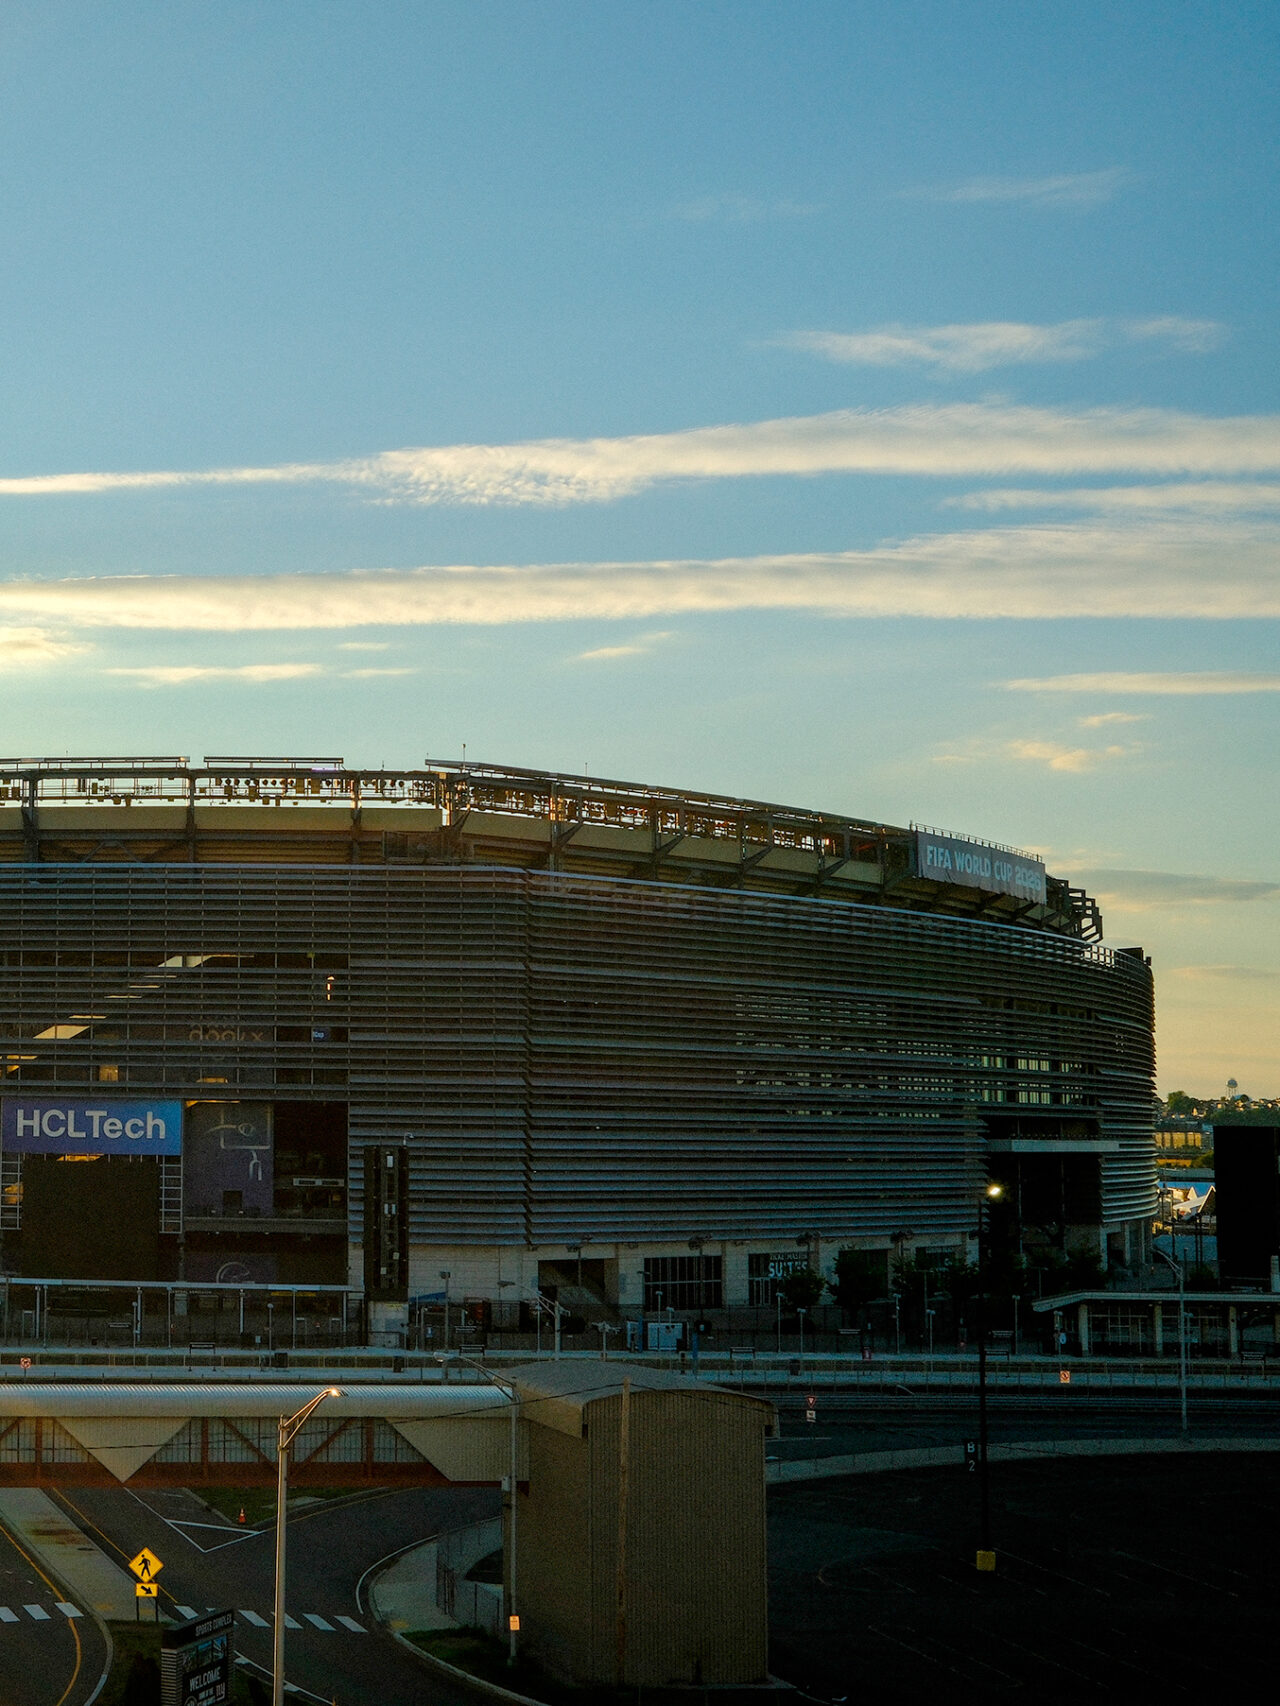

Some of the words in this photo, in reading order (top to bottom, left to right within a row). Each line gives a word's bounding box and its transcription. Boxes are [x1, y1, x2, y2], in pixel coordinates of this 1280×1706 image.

[926, 845, 952, 870] FIFA
[954, 850, 992, 878] WORLD
[994, 859, 1013, 882] CUP
[1015, 865, 1042, 892] 2026
[17, 1108, 166, 1140] HCLTech
[967, 1441, 976, 1453] B
[968, 1459, 976, 1472] 2
[189, 1666, 221, 1692] WELCOME
